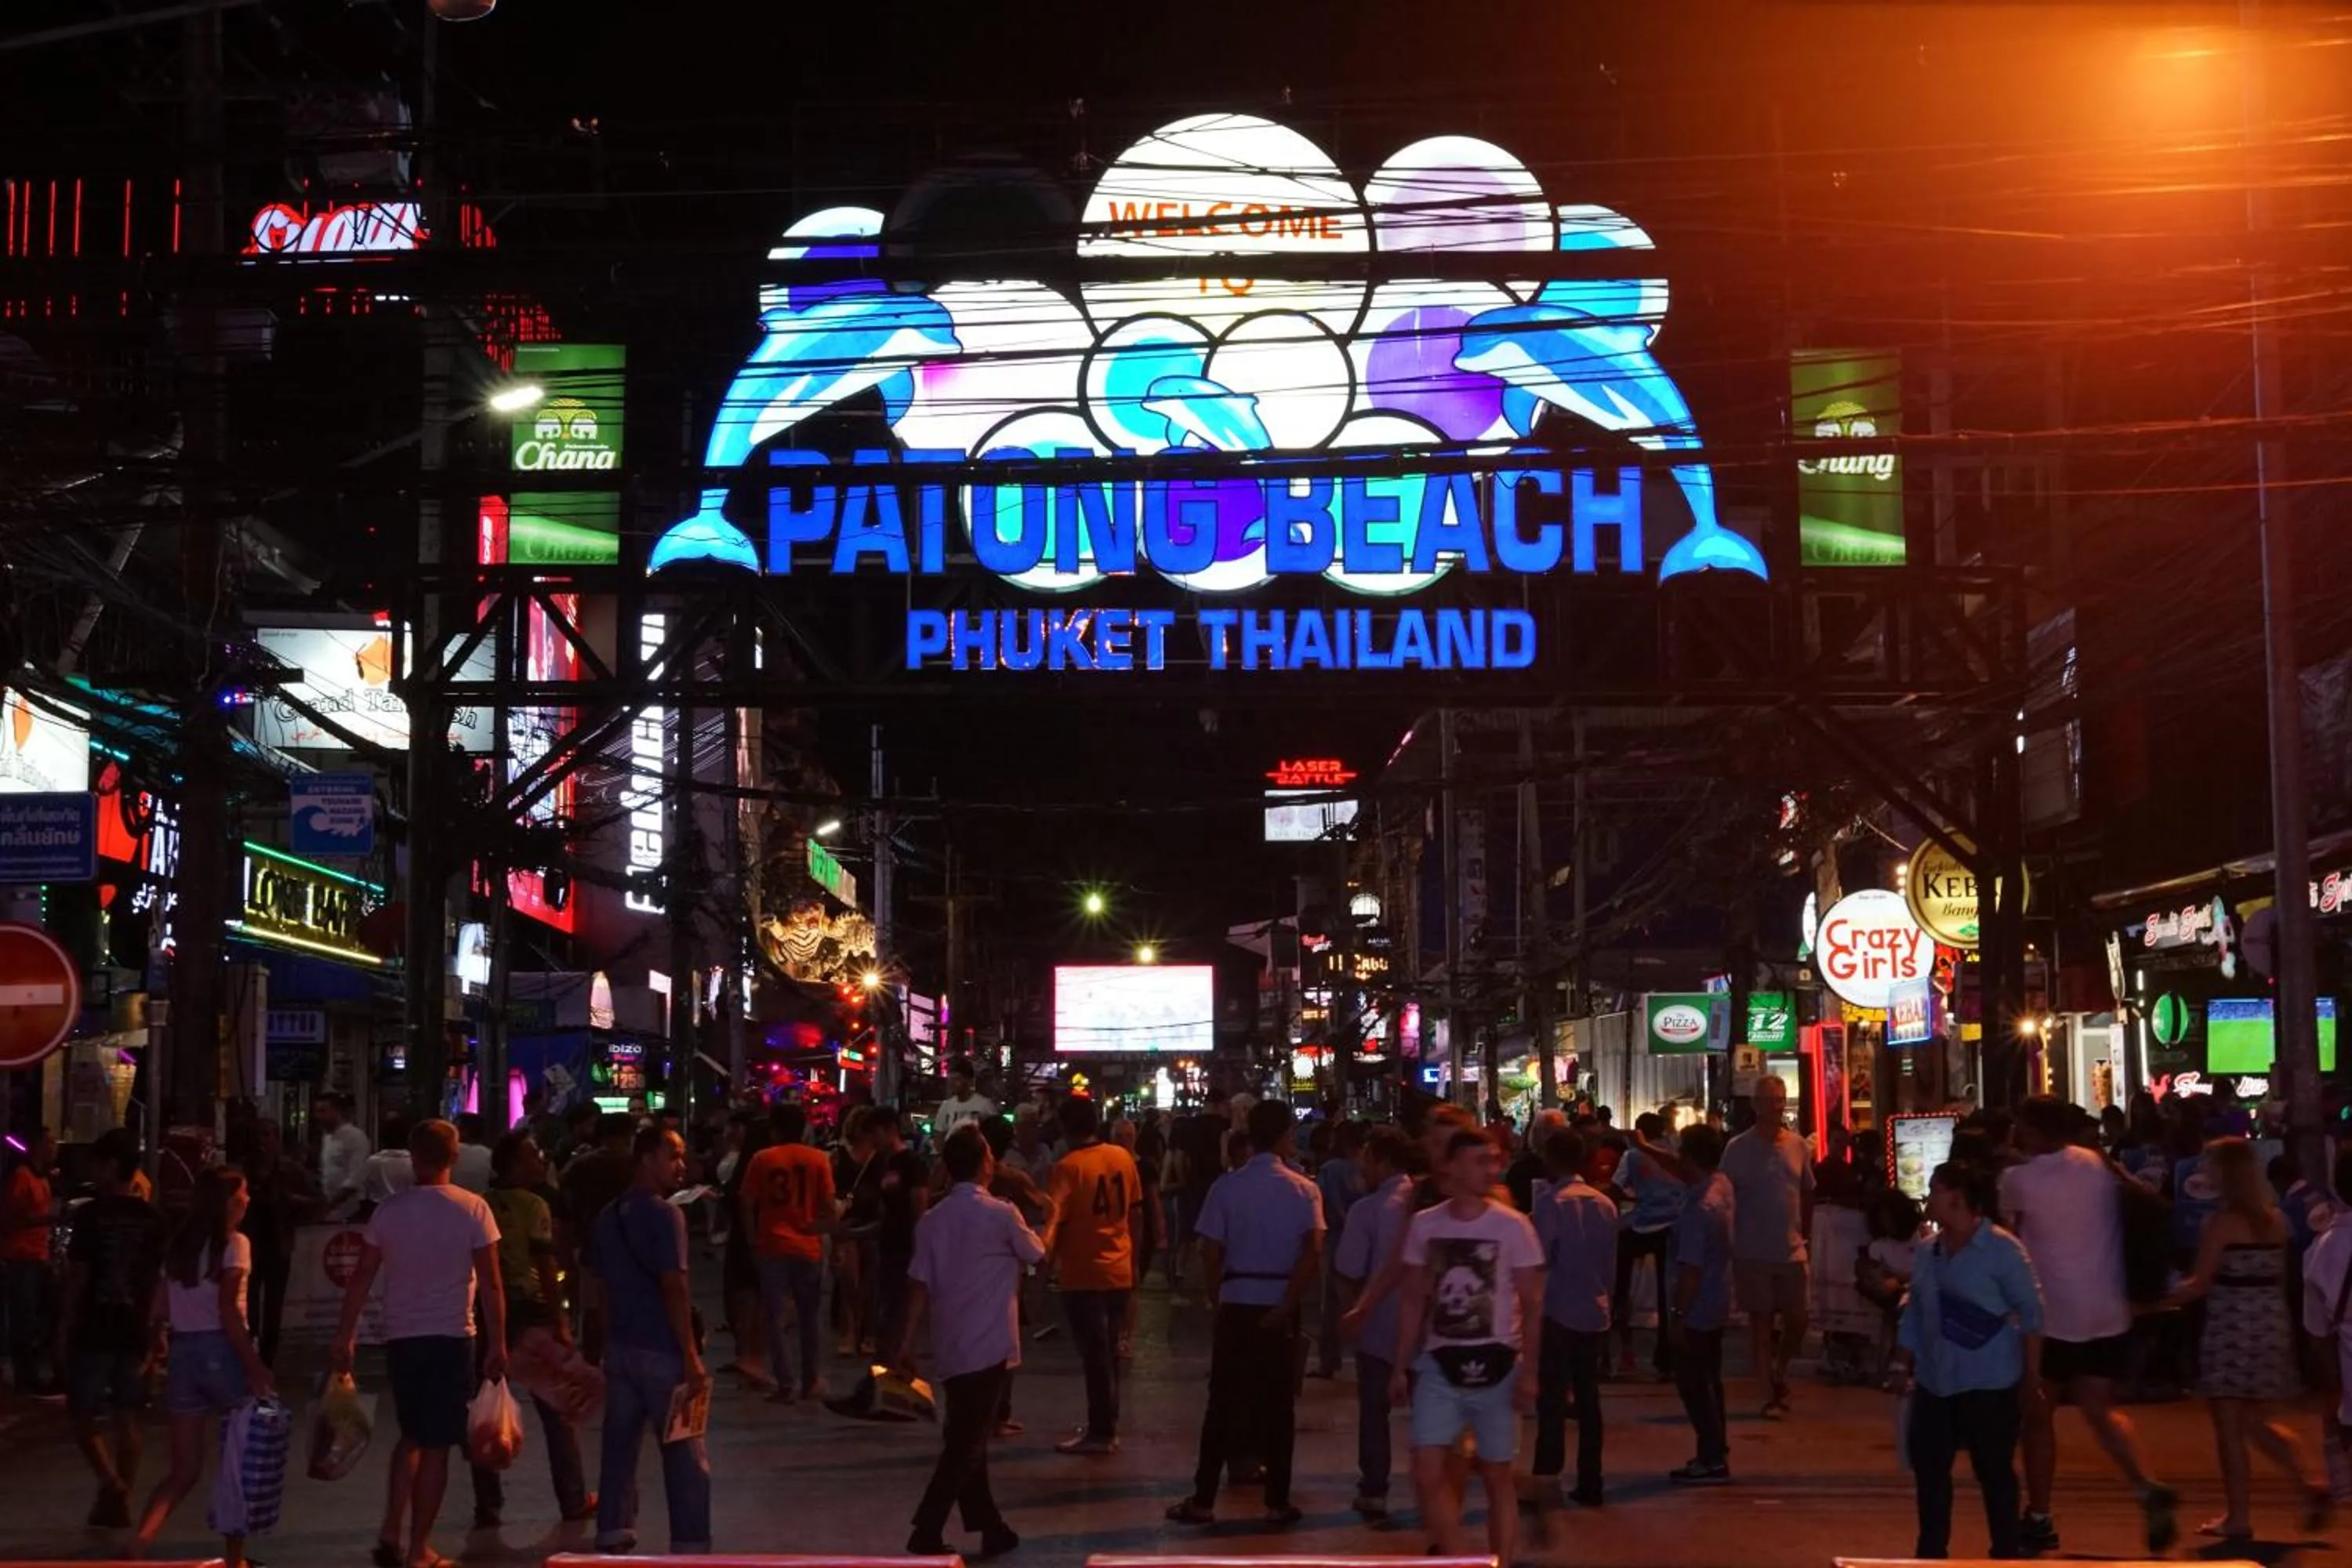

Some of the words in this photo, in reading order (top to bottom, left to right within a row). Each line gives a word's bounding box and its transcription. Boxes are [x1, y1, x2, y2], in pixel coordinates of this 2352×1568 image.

[1109, 201, 1343, 239] WELCOME
[768, 446, 1218, 575] PATONG
[1265, 448, 1644, 575] BEACH
[906, 608, 1175, 670] PHUKET
[1198, 608, 1537, 670] THAILAND
[1280, 760, 1342, 772] LASER
[1923, 873, 1979, 899] KEB
[1825, 918, 1922, 959] Crazy
[1827, 945, 1918, 980] Girls
[1663, 1016, 1697, 1027] PIZZA
[768, 1167, 805, 1209] 31
[1094, 1171, 1125, 1218] 41
